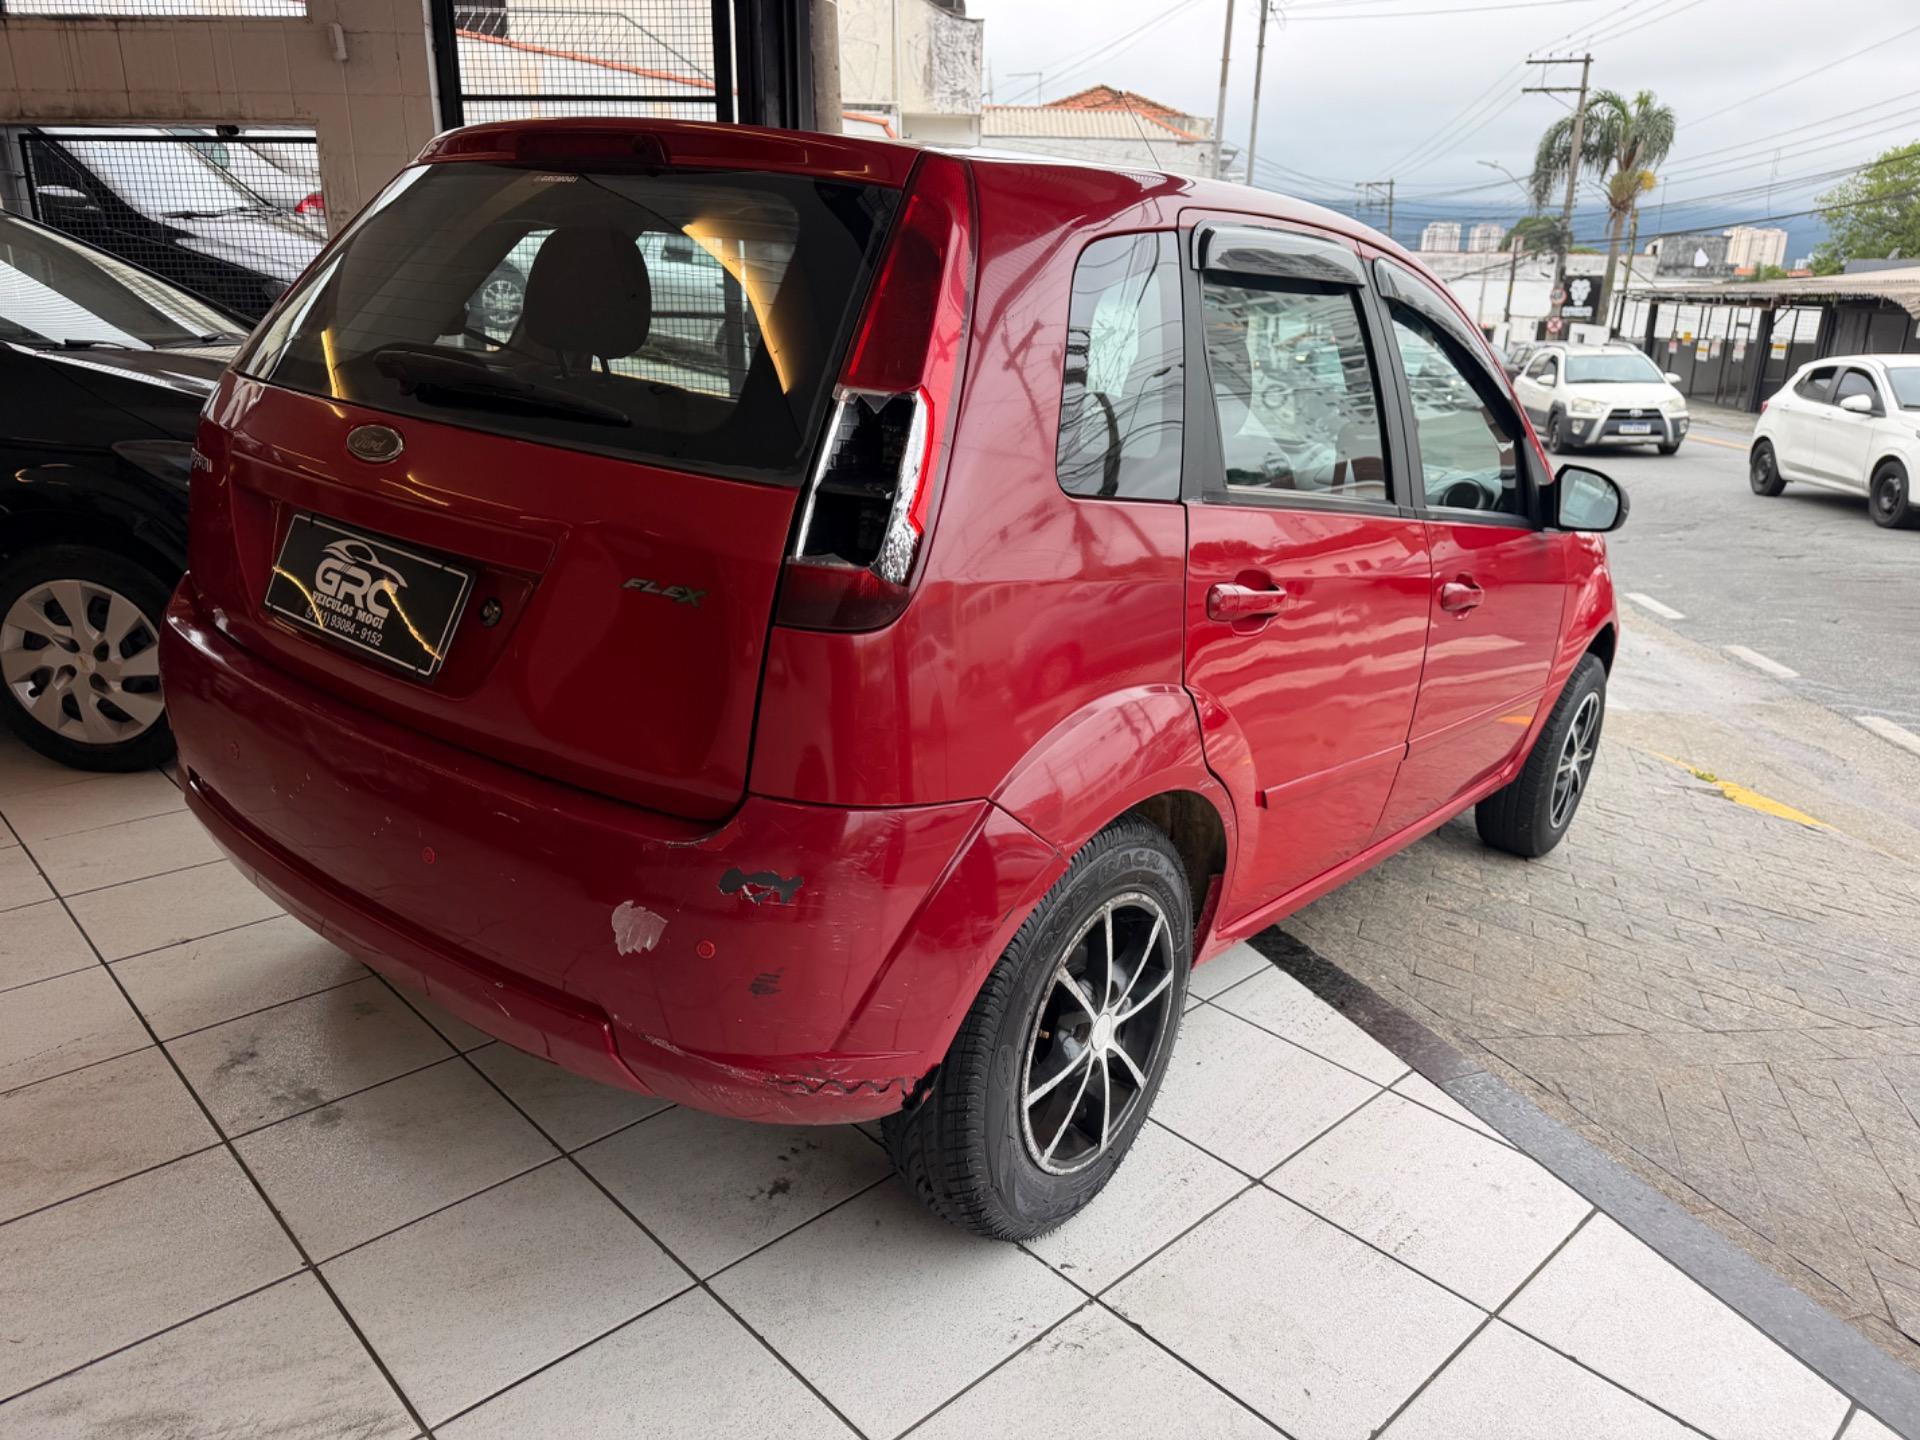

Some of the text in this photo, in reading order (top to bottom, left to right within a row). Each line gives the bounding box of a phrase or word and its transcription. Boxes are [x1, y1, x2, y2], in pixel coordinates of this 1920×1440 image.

[315, 557, 399, 619] GRC
[623, 578, 706, 608] FLEX
[312, 590, 385, 630] VEICULOS MOGI
